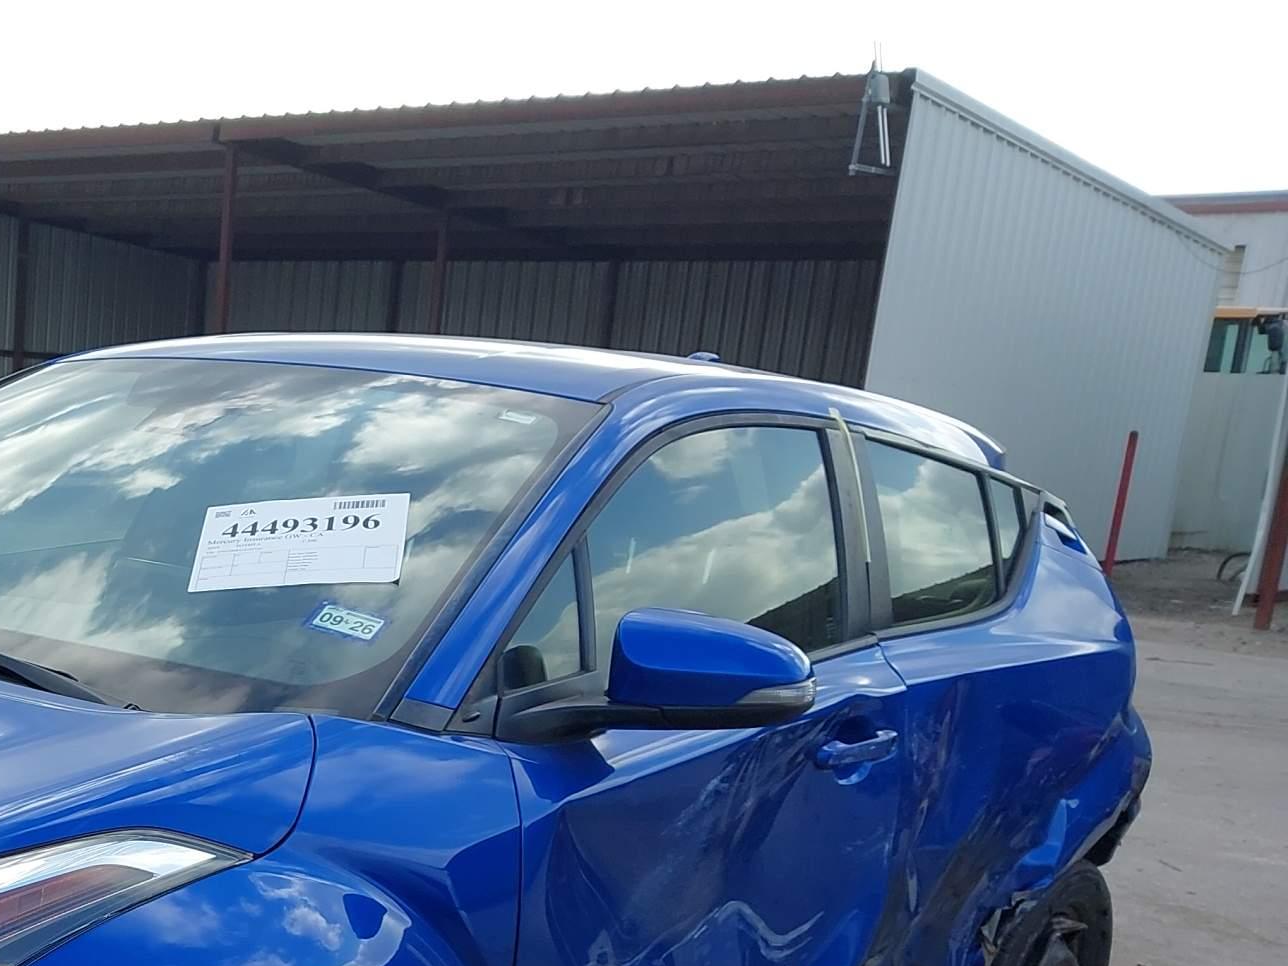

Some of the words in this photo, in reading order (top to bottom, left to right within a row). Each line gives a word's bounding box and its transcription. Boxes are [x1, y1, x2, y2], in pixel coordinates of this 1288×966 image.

[222, 513, 381, 538] 44493196
[319, 611, 345, 626] 09
[348, 620, 376, 635] 26
